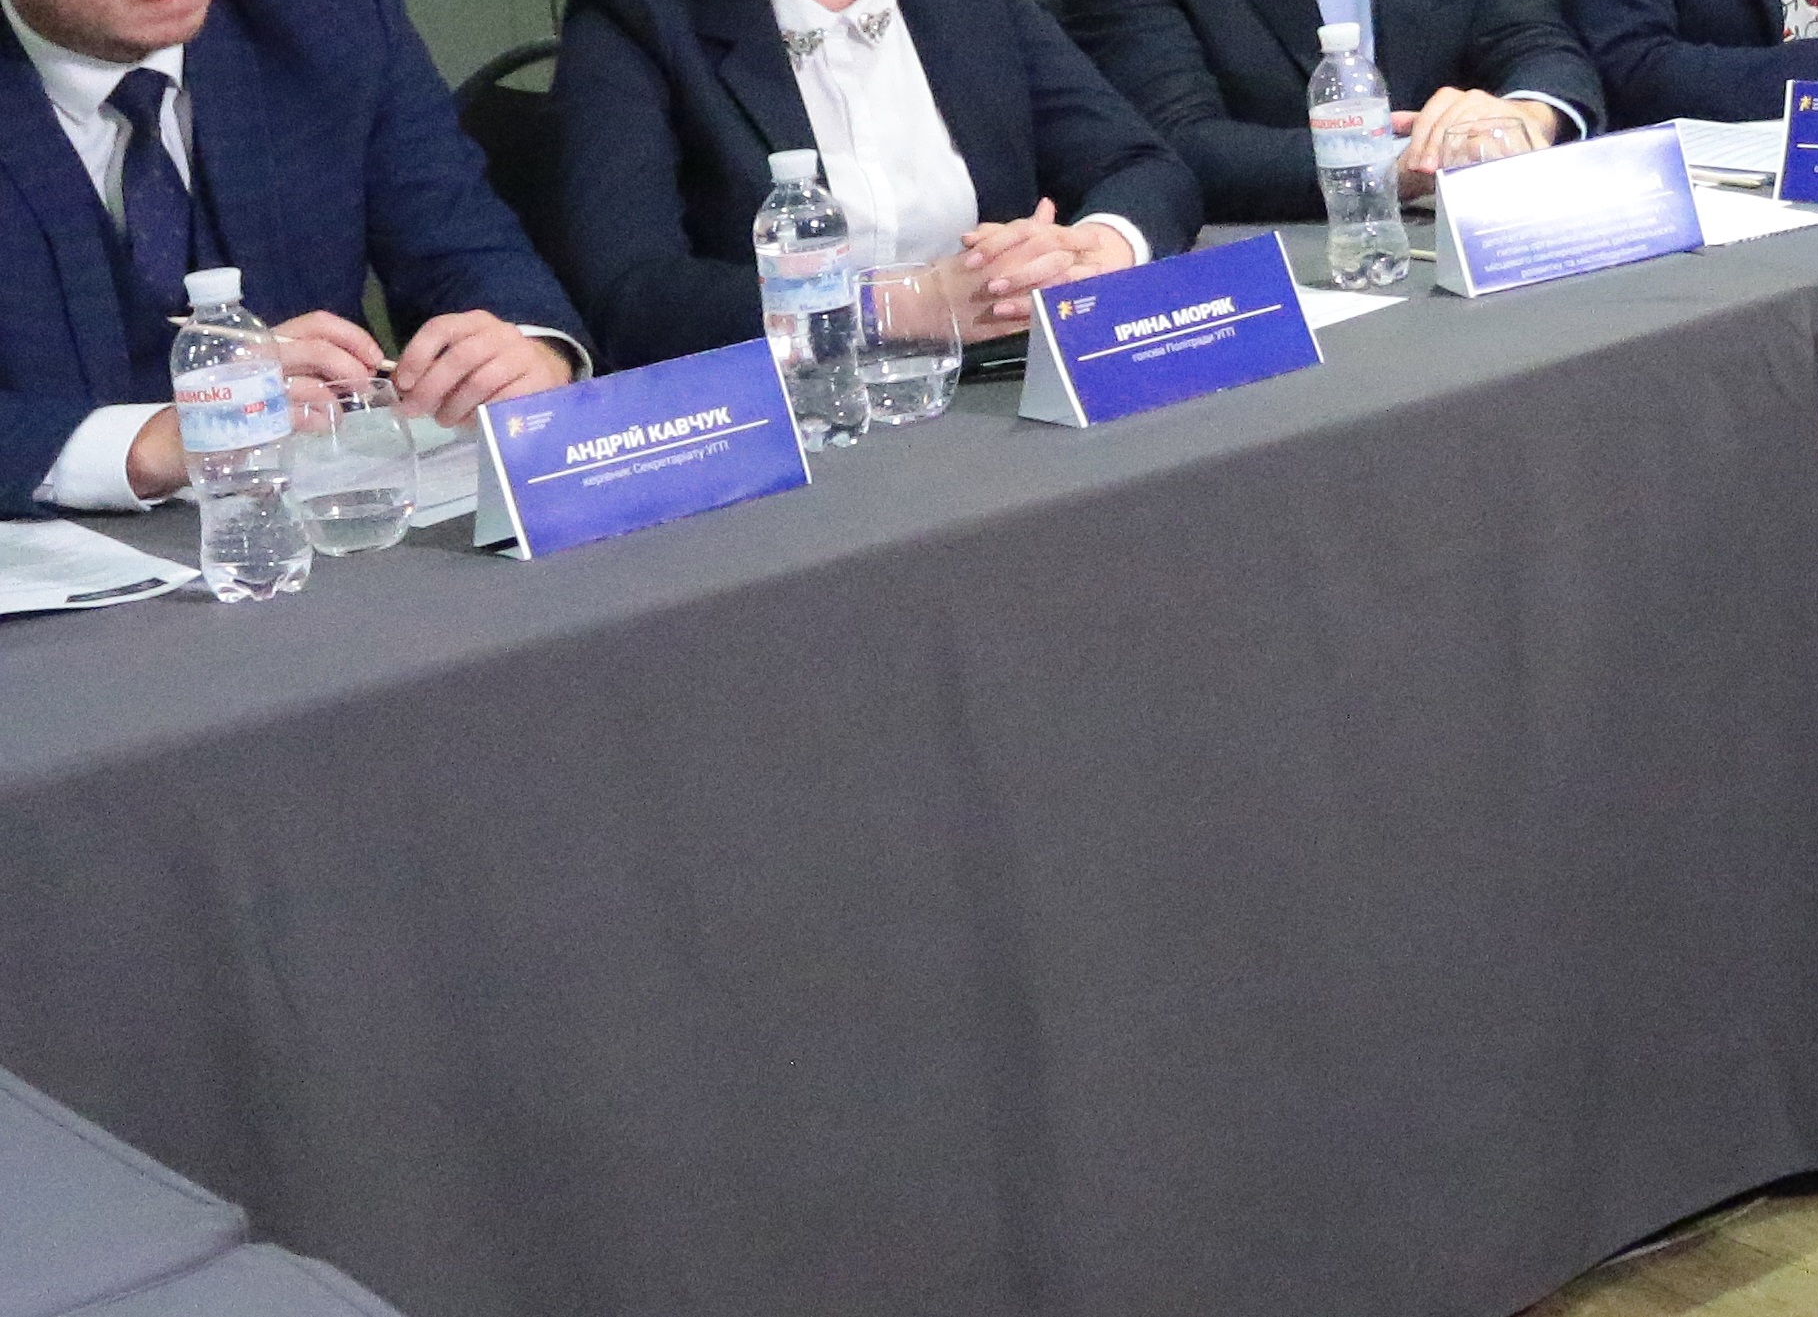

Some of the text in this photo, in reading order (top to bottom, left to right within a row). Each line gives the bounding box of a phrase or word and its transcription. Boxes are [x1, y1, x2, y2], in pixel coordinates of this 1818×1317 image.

[1114, 297, 1235, 342] ІРИНА МОРЯК
[567, 407, 732, 464] АНДРІЙ КАВЧУК
